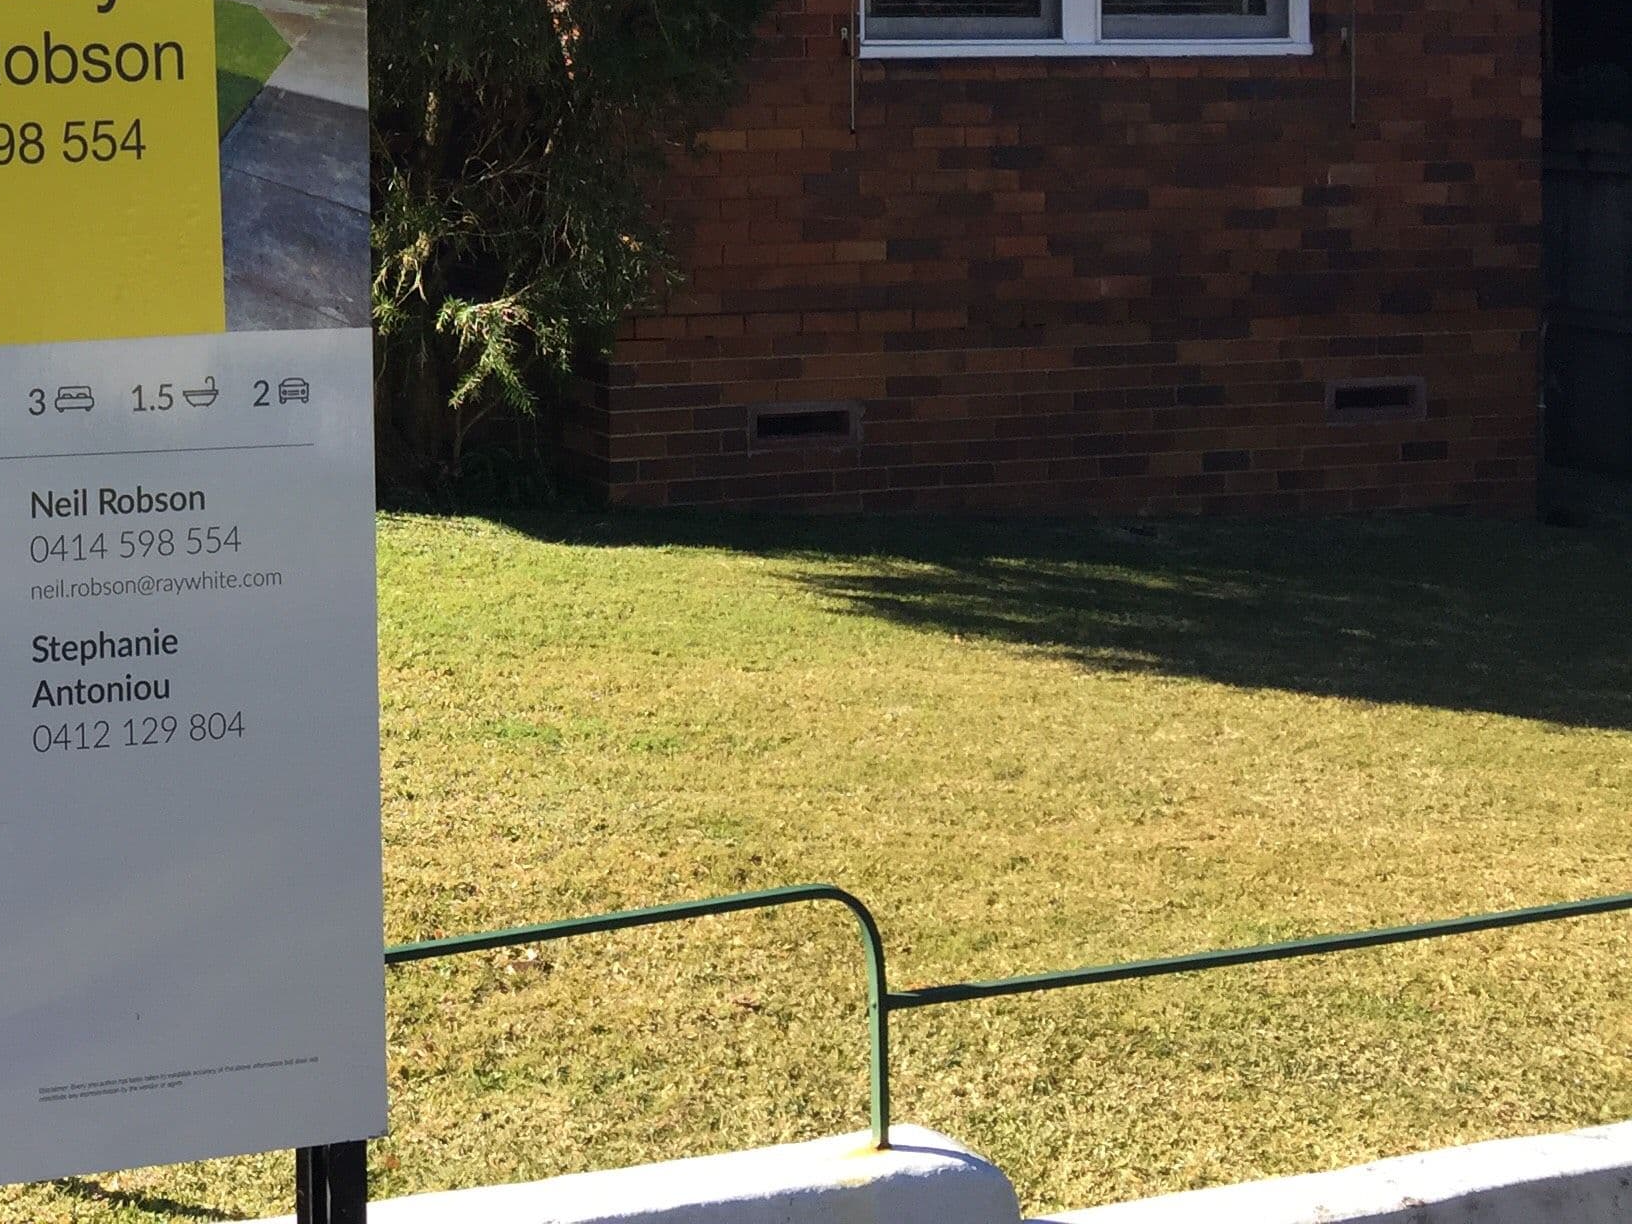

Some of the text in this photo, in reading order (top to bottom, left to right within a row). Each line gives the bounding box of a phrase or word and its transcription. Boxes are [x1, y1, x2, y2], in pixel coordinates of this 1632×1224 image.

[63, 118, 146, 163] 554
[29, 380, 270, 416] 3 1.5 2
[31, 485, 205, 519] Neil Robson
[30, 526, 241, 563] 0414 598 554
[32, 571, 281, 599] neil.robson@raywhite.com
[32, 628, 178, 666] Stephanie
[32, 673, 169, 708] Antoniou
[33, 711, 245, 752] 0412 129 804
